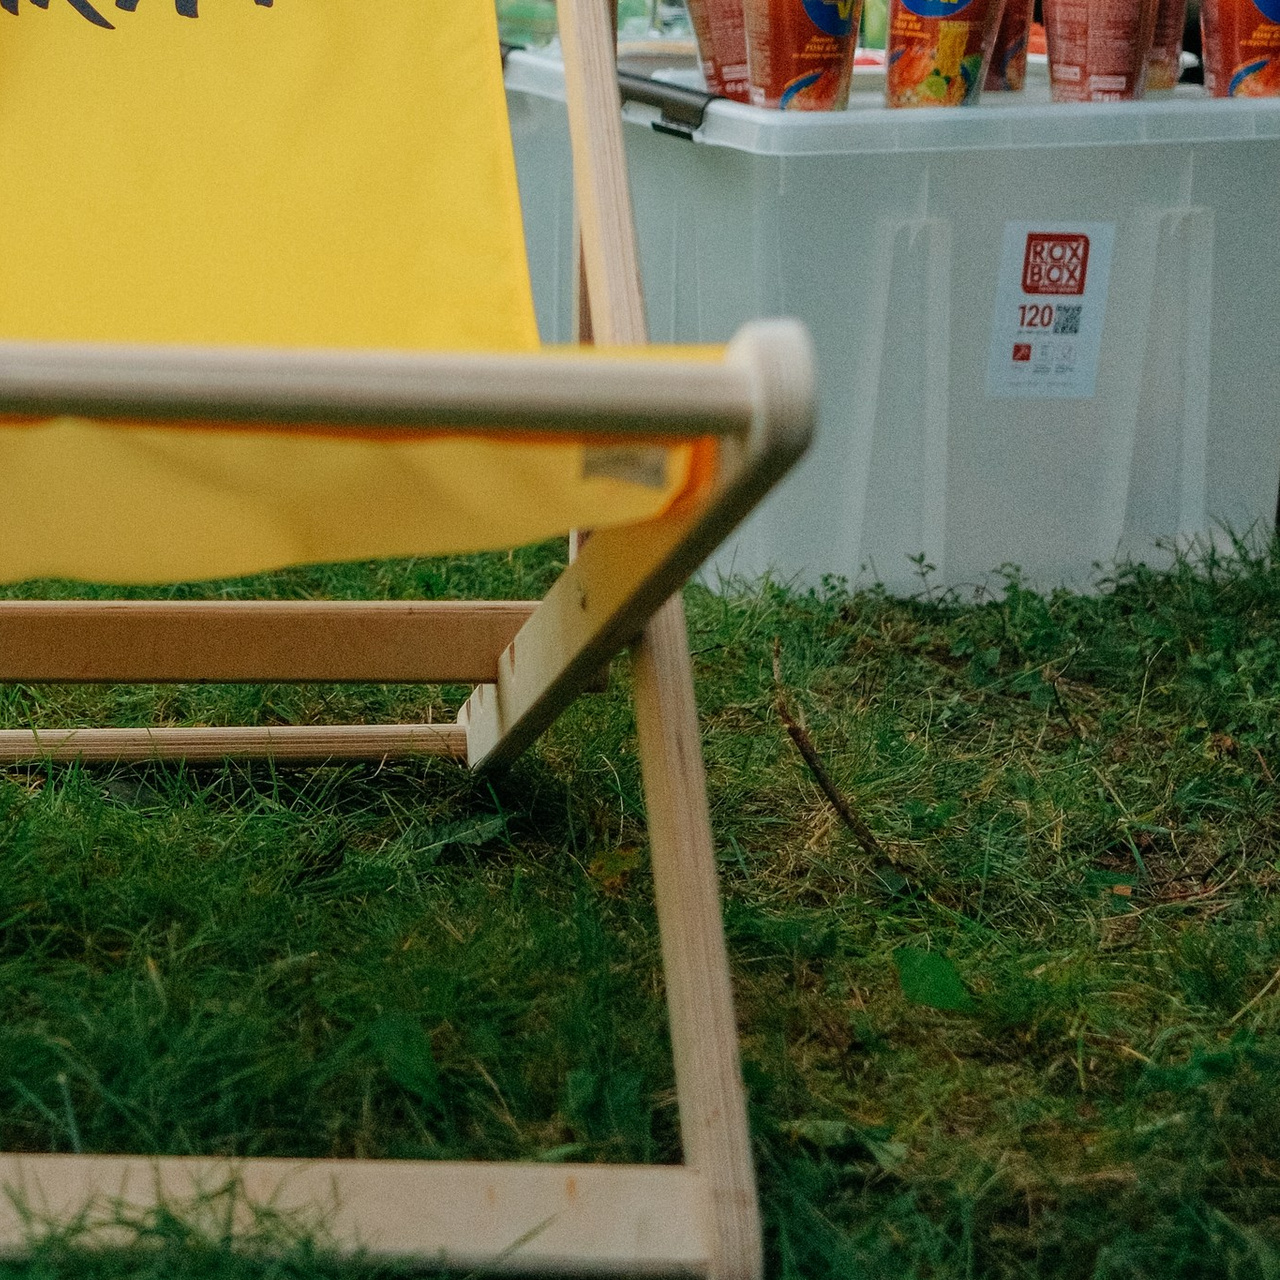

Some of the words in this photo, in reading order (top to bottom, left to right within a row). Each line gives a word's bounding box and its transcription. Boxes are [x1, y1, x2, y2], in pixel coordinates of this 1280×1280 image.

[1031, 242, 1082, 262] ROX
[1030, 264, 1080, 283] BOX
[1018, 303, 1054, 328] 120
